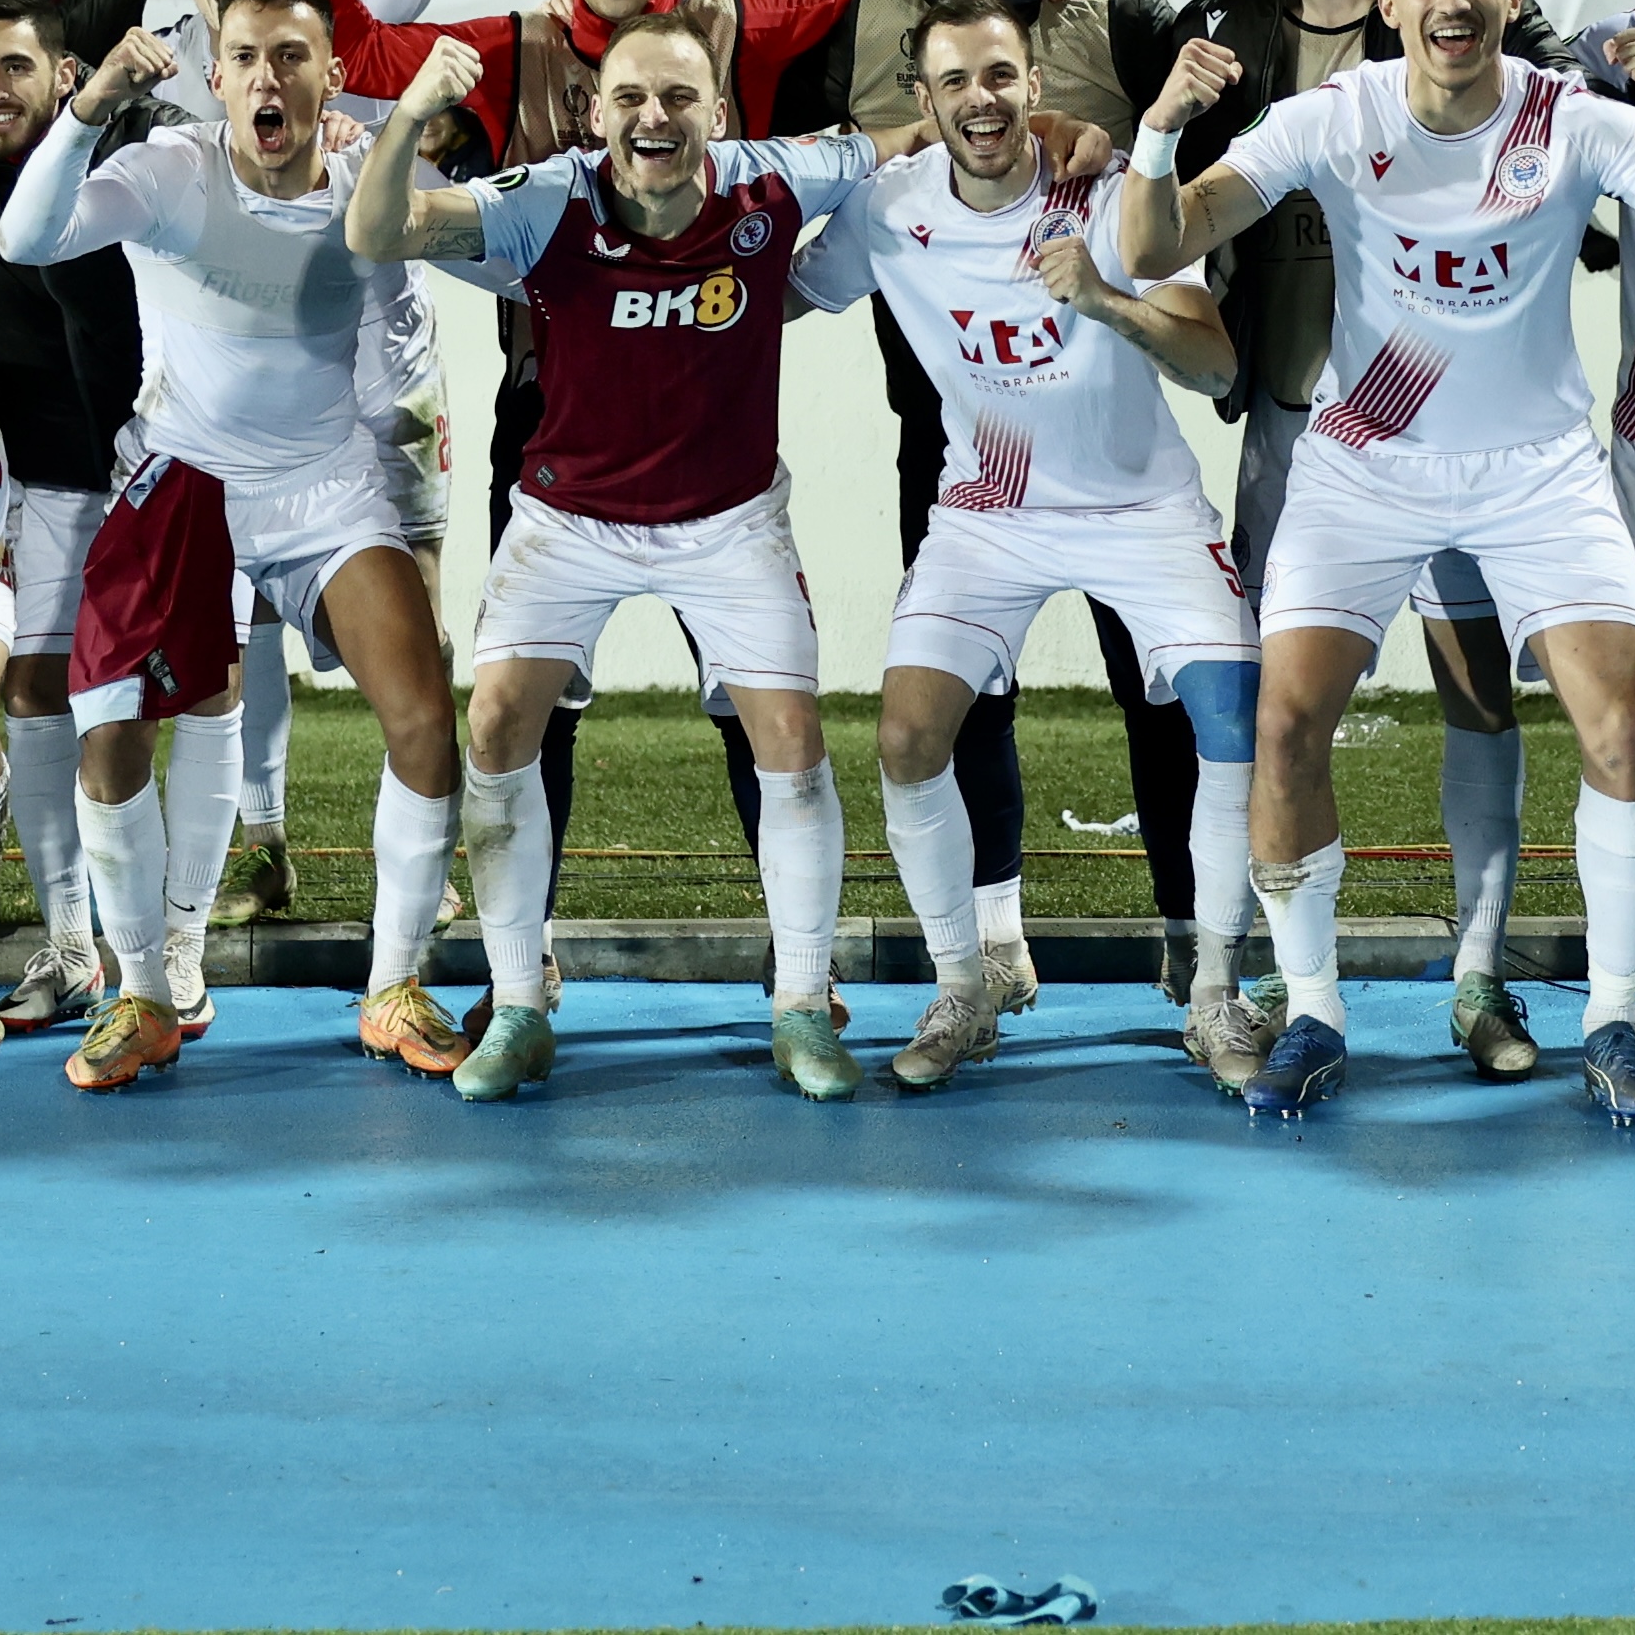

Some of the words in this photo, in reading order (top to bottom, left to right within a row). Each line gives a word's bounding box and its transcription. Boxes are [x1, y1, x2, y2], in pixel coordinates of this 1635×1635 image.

[610, 270, 741, 330] BK8
[1423, 295, 1509, 308] ABRAHAM
[992, 370, 1070, 389] ABRAHAM
[1206, 541, 1245, 599] 5
